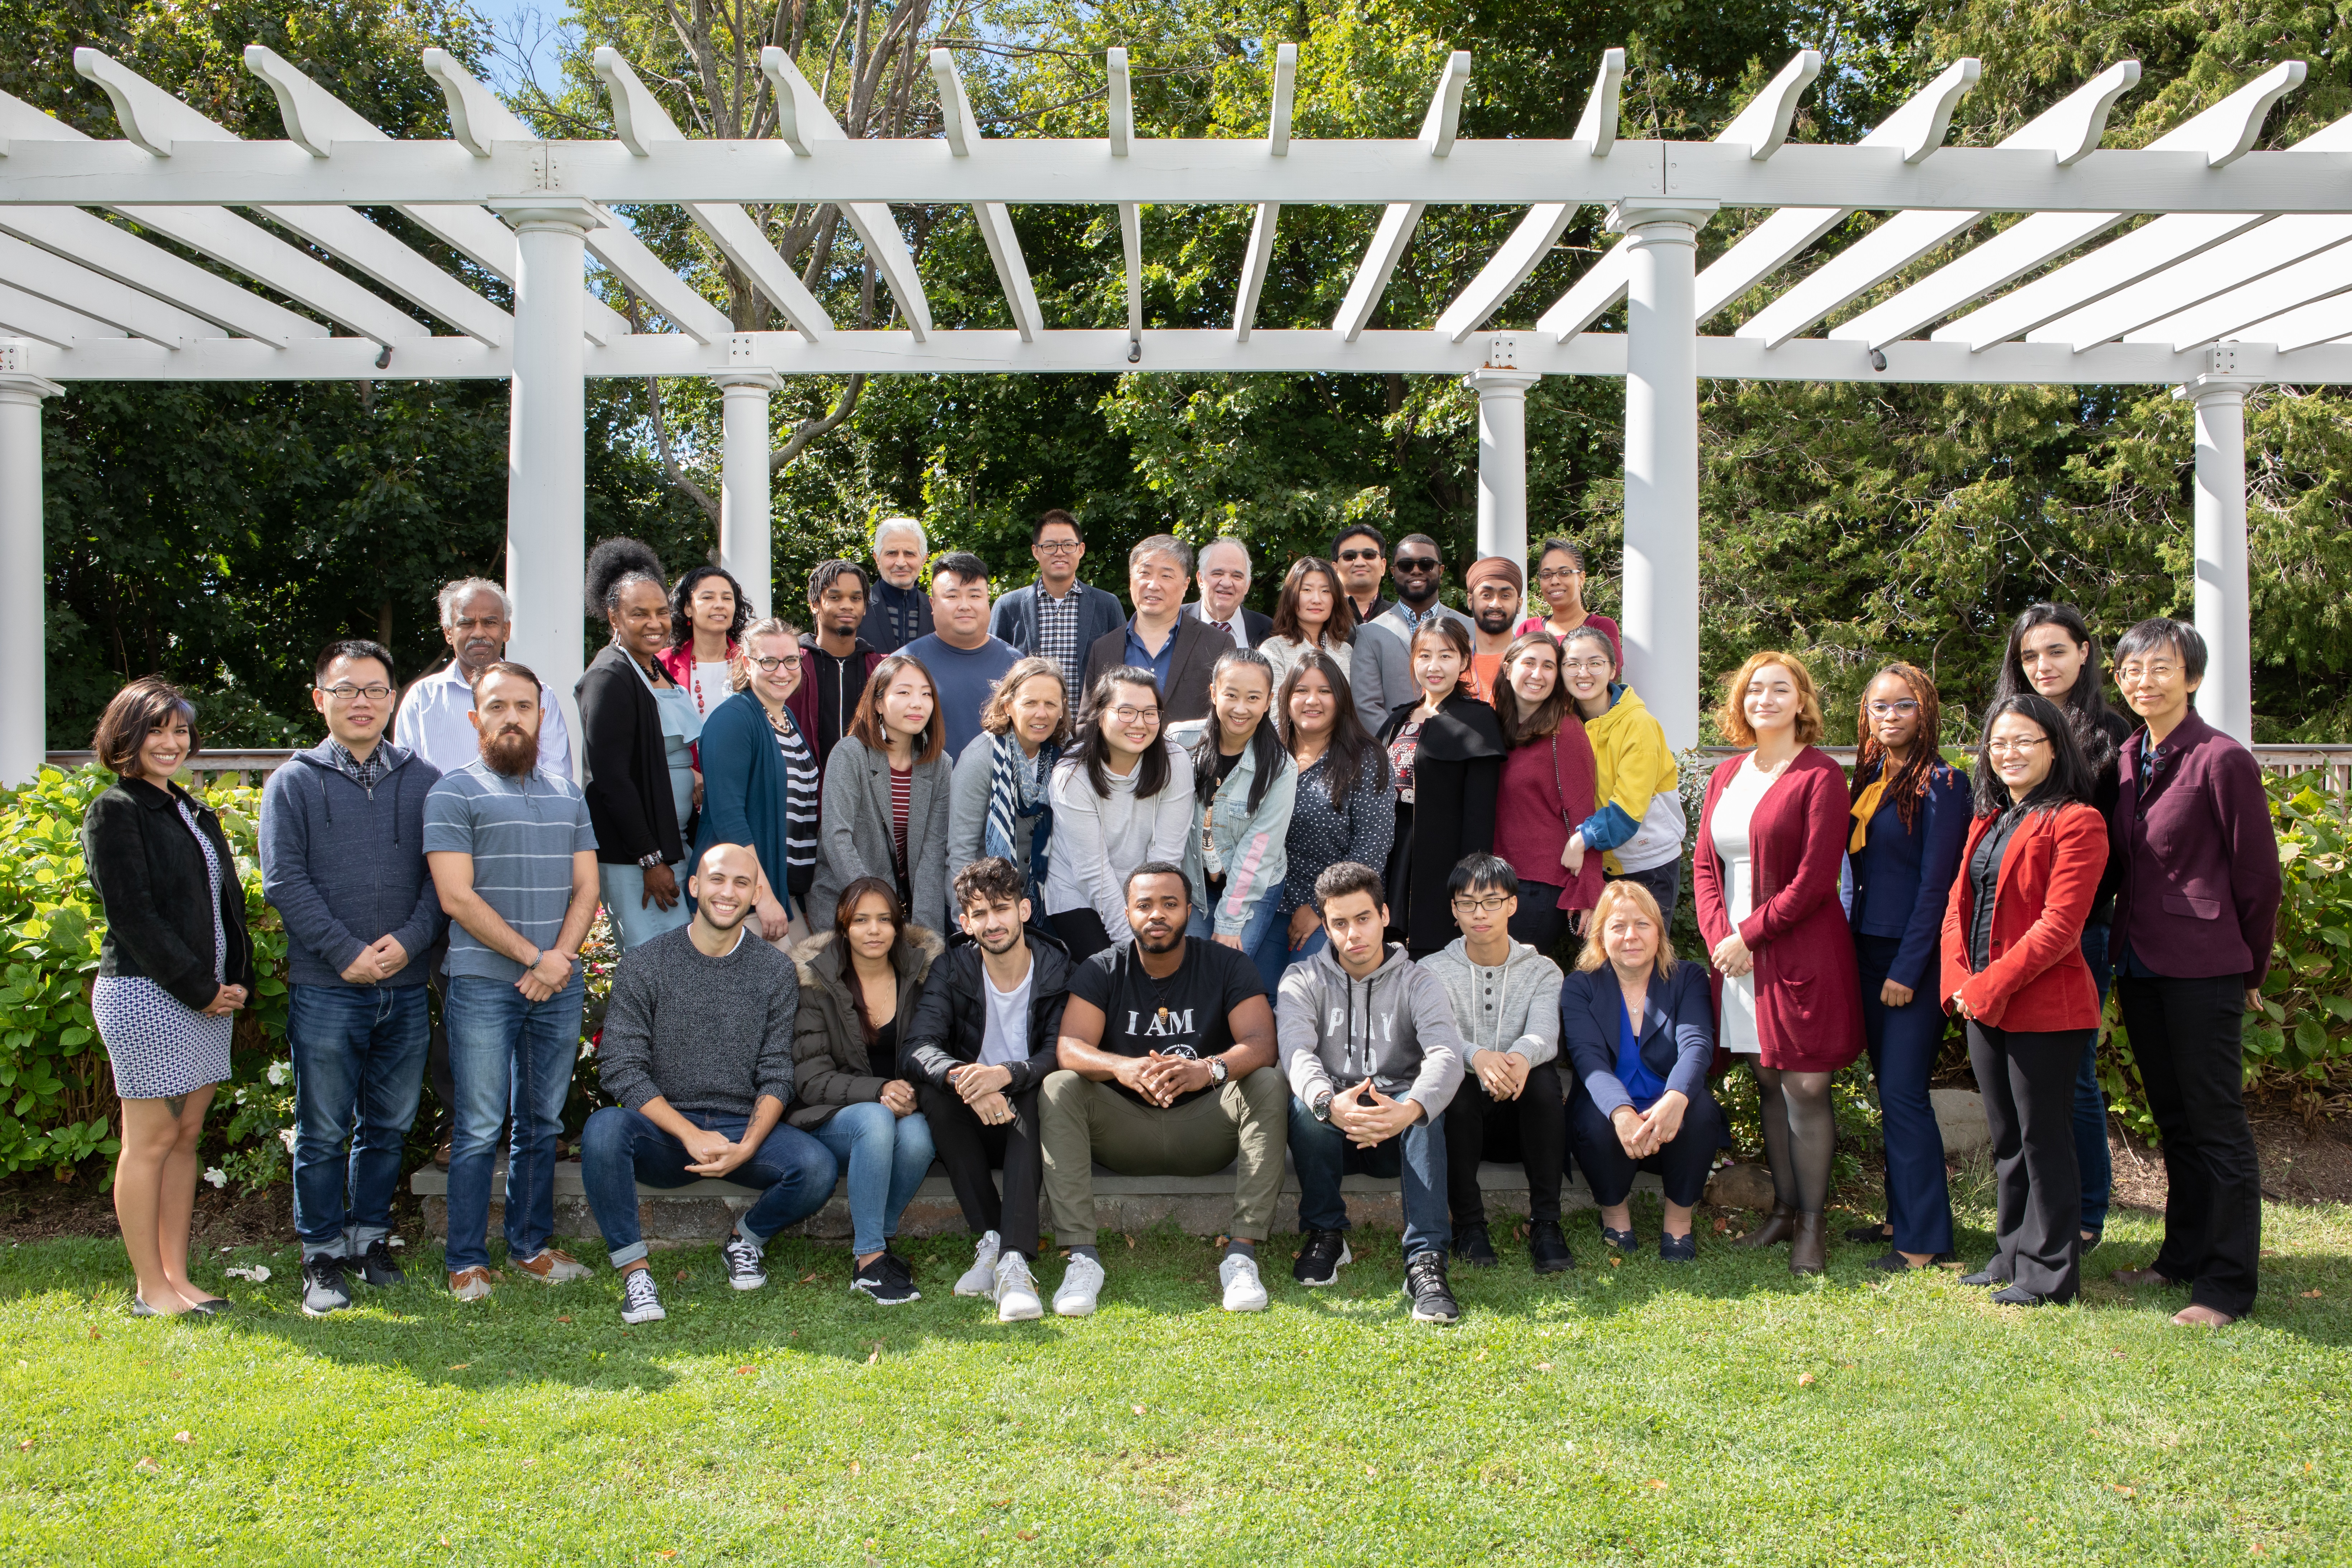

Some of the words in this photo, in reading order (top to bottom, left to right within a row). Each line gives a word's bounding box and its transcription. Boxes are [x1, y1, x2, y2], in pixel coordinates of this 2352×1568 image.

[1125, 1011, 1139, 1035] I
[1144, 1009, 1195, 1036] AM
[1327, 1007, 1393, 1042] PLAY
[1343, 1044, 1377, 1076] TO
